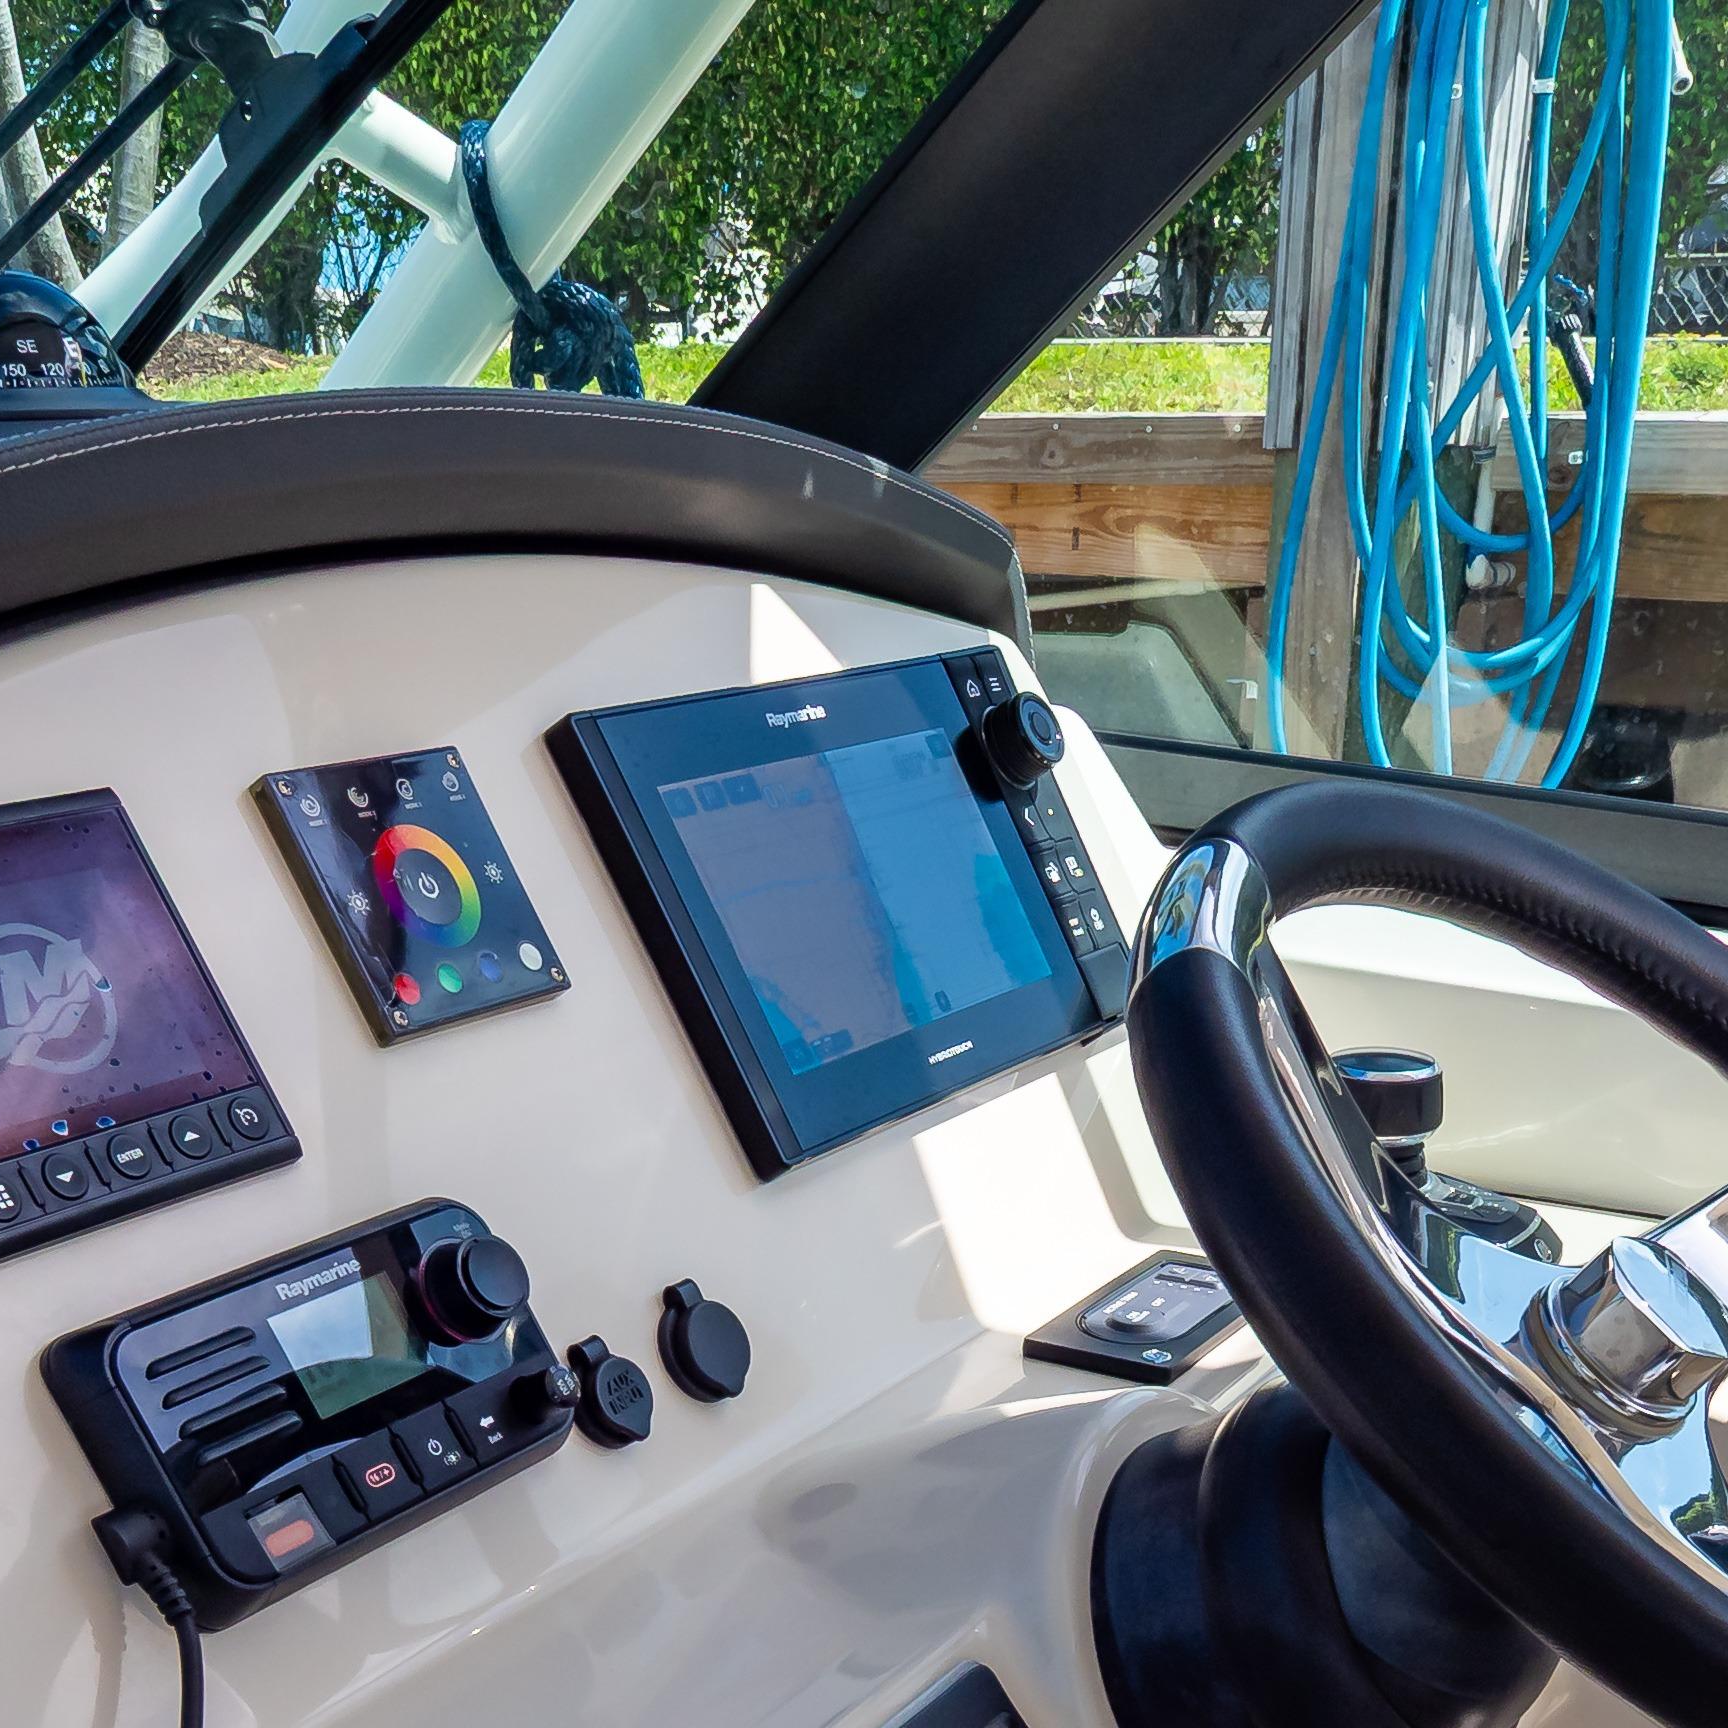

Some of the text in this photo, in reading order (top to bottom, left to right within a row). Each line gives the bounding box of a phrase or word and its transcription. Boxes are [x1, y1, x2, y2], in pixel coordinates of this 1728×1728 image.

[16, 339, 39, 353] SE
[2, 364, 26, 376] 150
[41, 363, 64, 376] 120
[766, 704, 826, 728] Raymarine
[117, 1148, 144, 1164] ENTER
[275, 1258, 361, 1301] Raymarine
[607, 1369, 634, 1396] AUX
